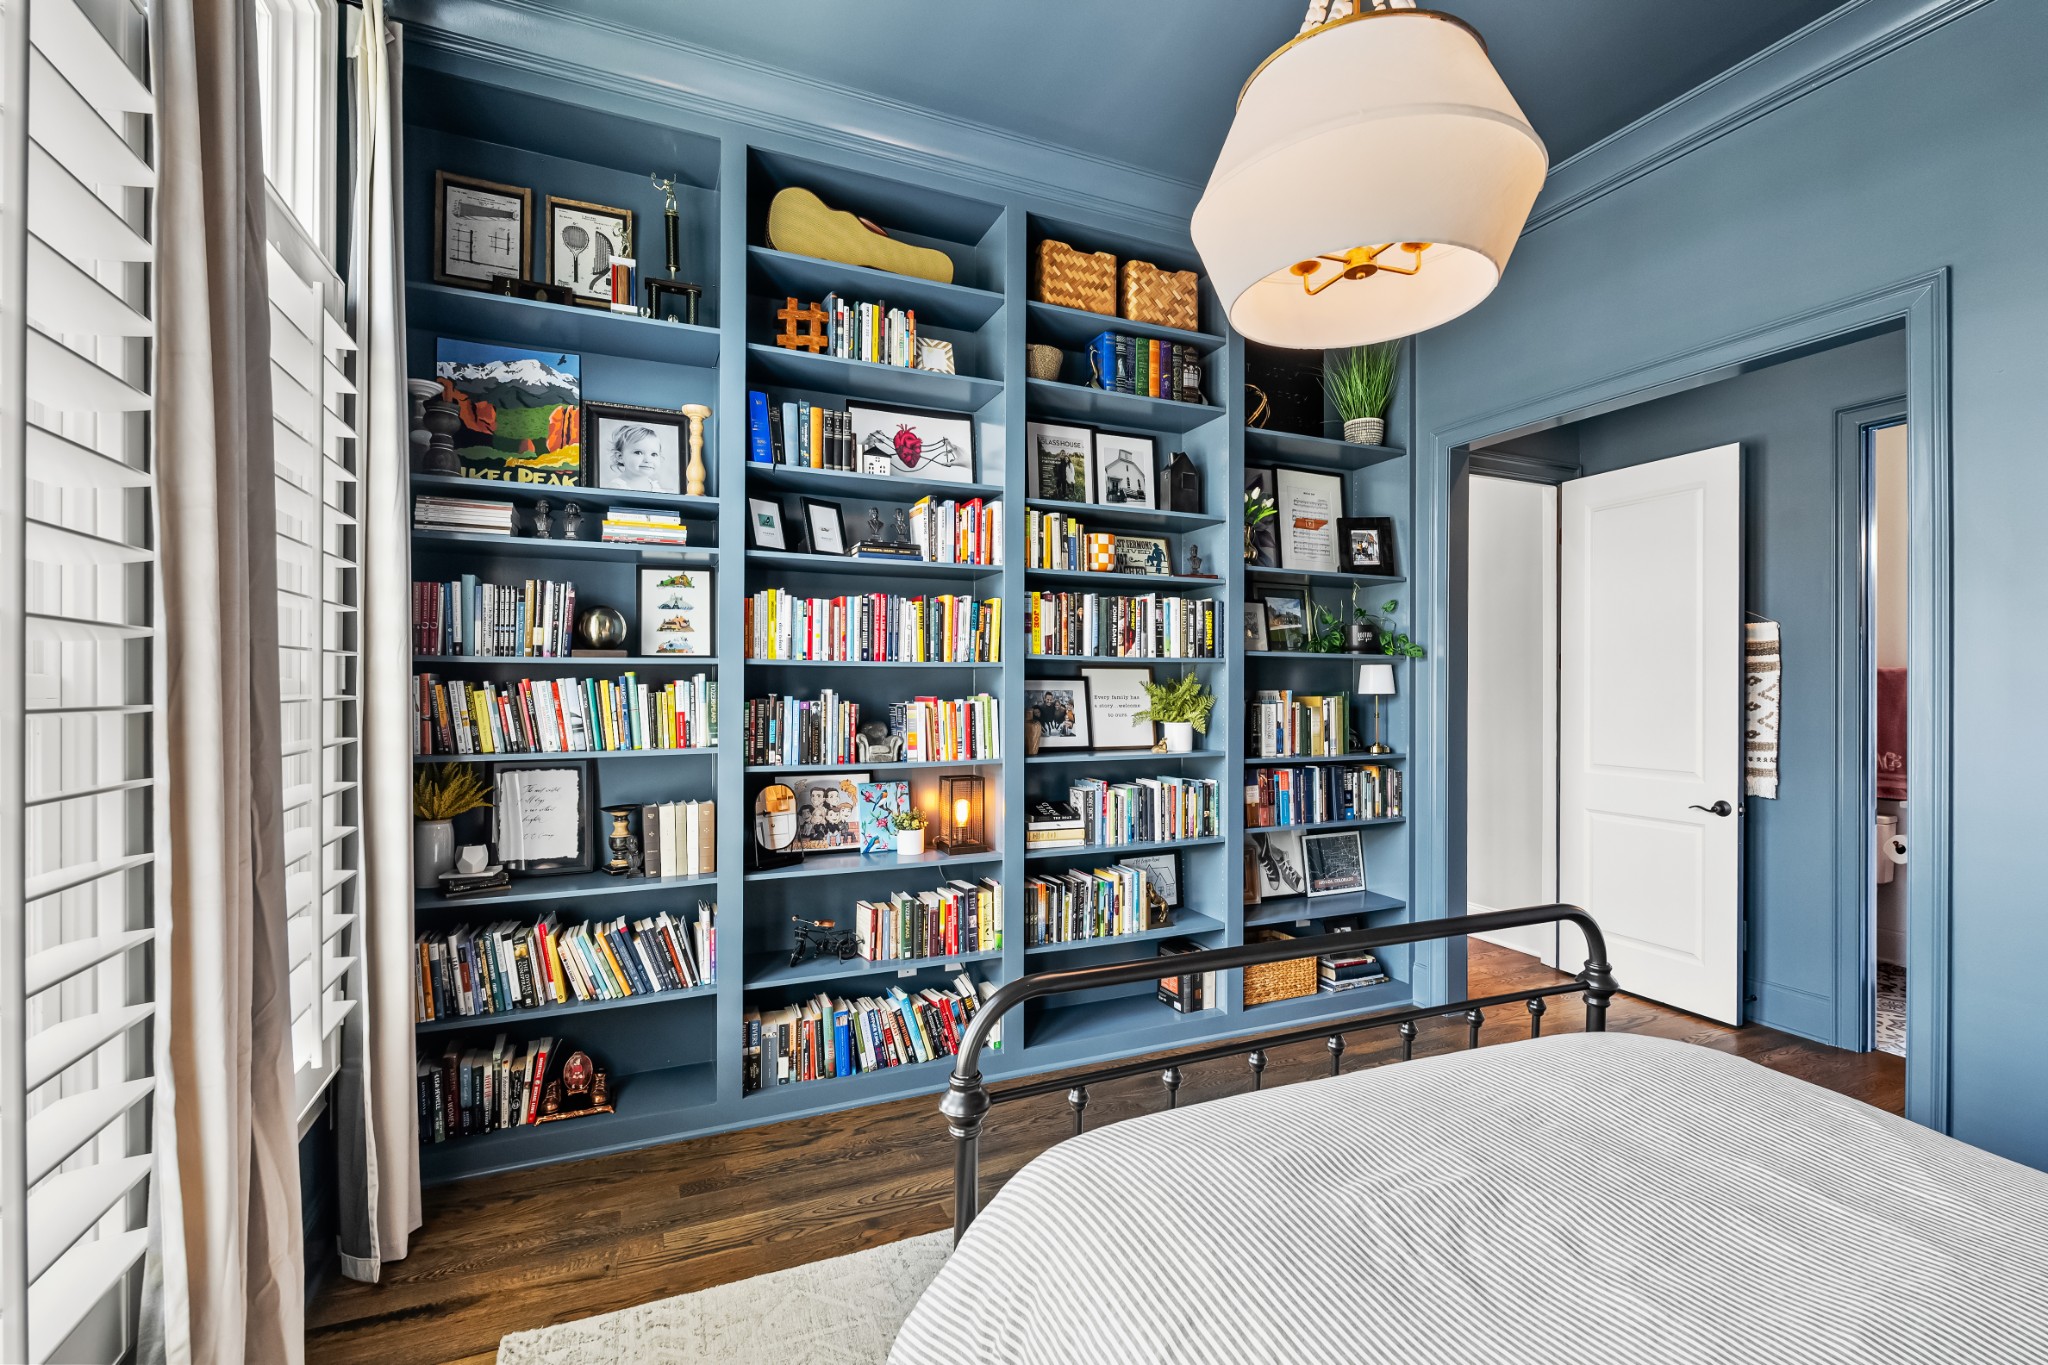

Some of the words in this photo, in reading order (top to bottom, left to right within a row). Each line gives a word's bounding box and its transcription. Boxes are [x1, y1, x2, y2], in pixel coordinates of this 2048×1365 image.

[1126, 540, 1152, 550] SERMONS
[517, 961, 528, 995] CONSPIRACY
[524, 974, 532, 994] DIVINE
[872, 1032, 881, 1046] KING
[536, 1057, 544, 1078] MONEYBALL
[447, 1102, 455, 1127] WOMEN
